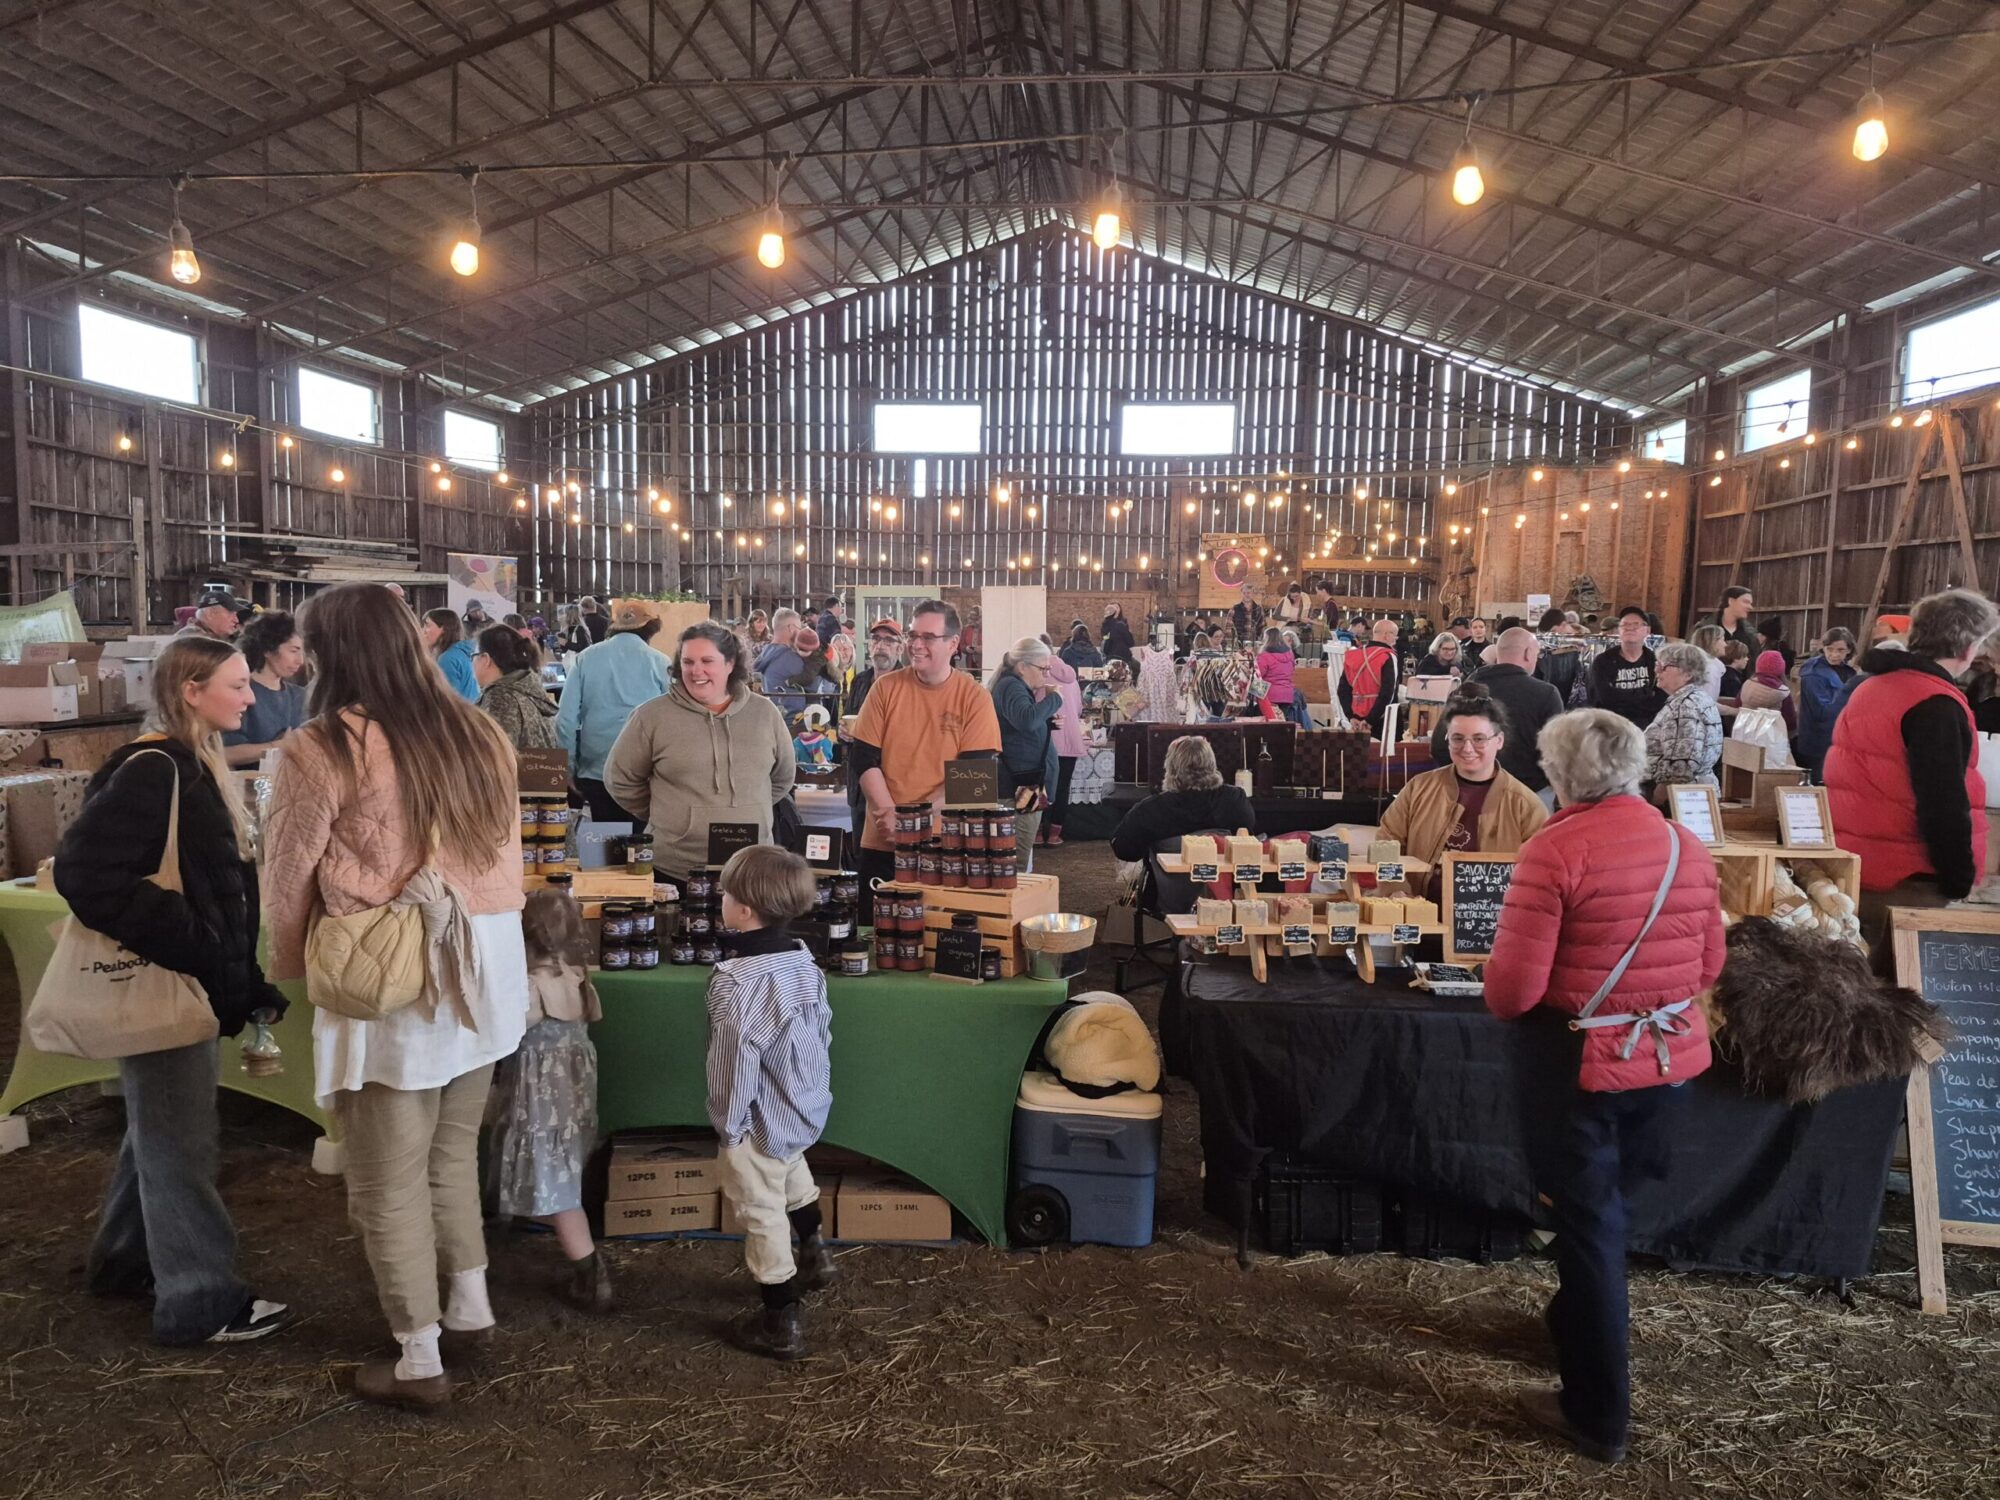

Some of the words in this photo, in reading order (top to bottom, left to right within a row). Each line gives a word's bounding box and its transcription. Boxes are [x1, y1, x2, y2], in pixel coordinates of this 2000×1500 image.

[950, 767, 993, 780] Salsa
[974, 783, 988, 797] 8$
[1924, 975, 1972, 992] Mouton
[1937, 1065, 1970, 1085] Peau
[1976, 1073, 1998, 1089] de
[1946, 1117, 2000, 1145] Sheep
[627, 1172, 656, 1182] 12PCS
[674, 1169, 703, 1179] 212ML
[623, 1209, 652, 1218] 12PCS
[671, 1206, 699, 1215] 212ML
[860, 1203, 882, 1211] 12PCS
